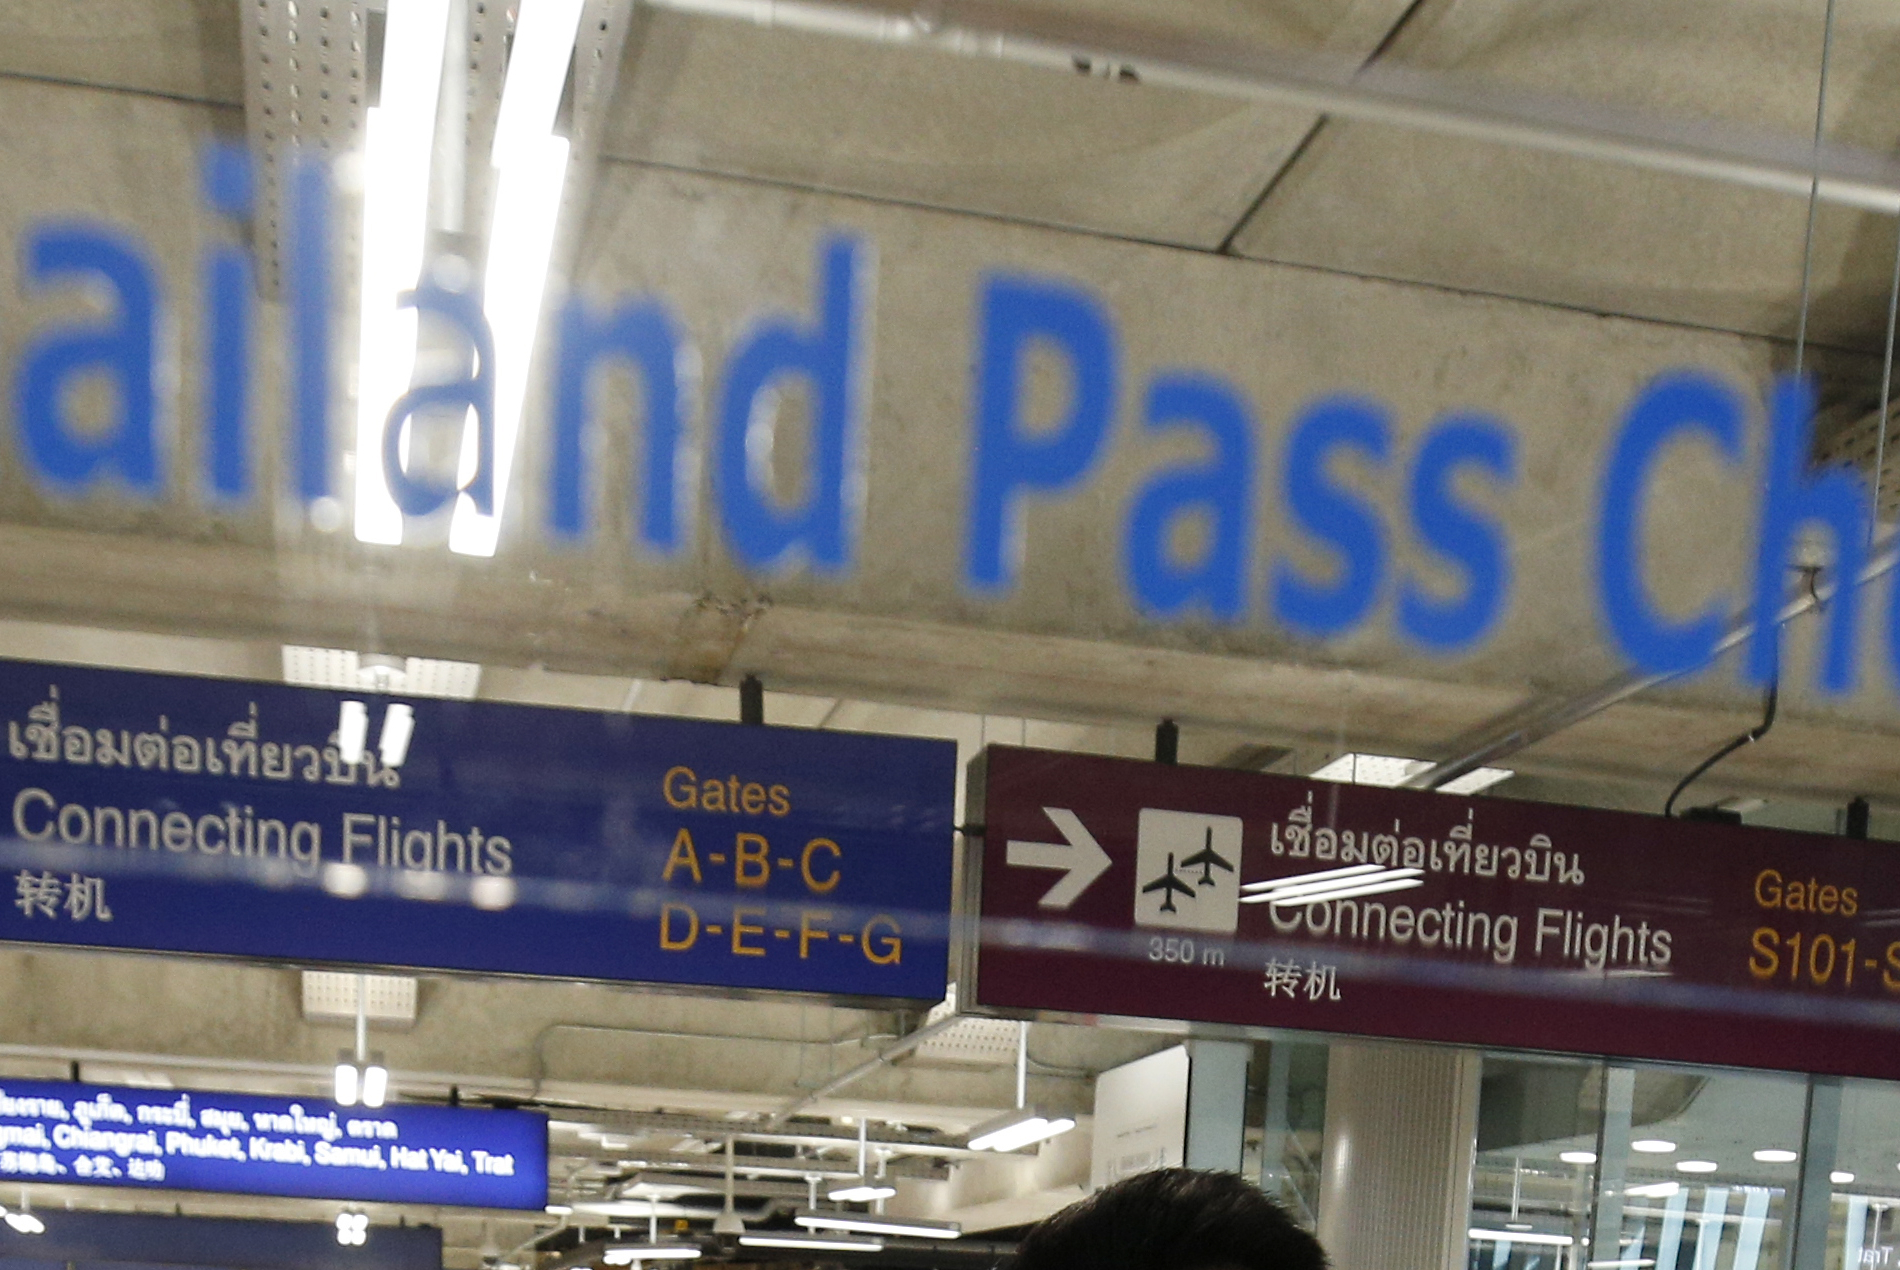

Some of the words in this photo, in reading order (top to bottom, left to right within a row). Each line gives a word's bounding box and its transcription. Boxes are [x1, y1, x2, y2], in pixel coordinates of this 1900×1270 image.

[961, 268, 1525, 652] Pass
[662, 765, 790, 818] Gates
[12, 787, 322, 869] Connecting
[340, 812, 513, 878] Flights
[662, 828, 842, 892] A-B-C
[15, 870, 112, 922] 转机
[1754, 869, 1859, 918] Gates
[659, 904, 901, 965] D-E-F-G
[1147, 937, 1194, 966] 350
[1201, 948, 1226, 969] m
[1269, 898, 1518, 964] Connecting
[1535, 905, 1672, 970] Flights
[1263, 958, 1342, 1001] 转机
[52, 1124, 163, 1157] Chiangrai,
[165, 1130, 246, 1162] Phuket,
[249, 1136, 312, 1166] Krabi,
[314, 1141, 387, 1170] Samui,
[389, 1145, 428, 1170] Hat
[428, 1147, 469, 1175] Yai,
[471, 1150, 515, 1176] Trat
